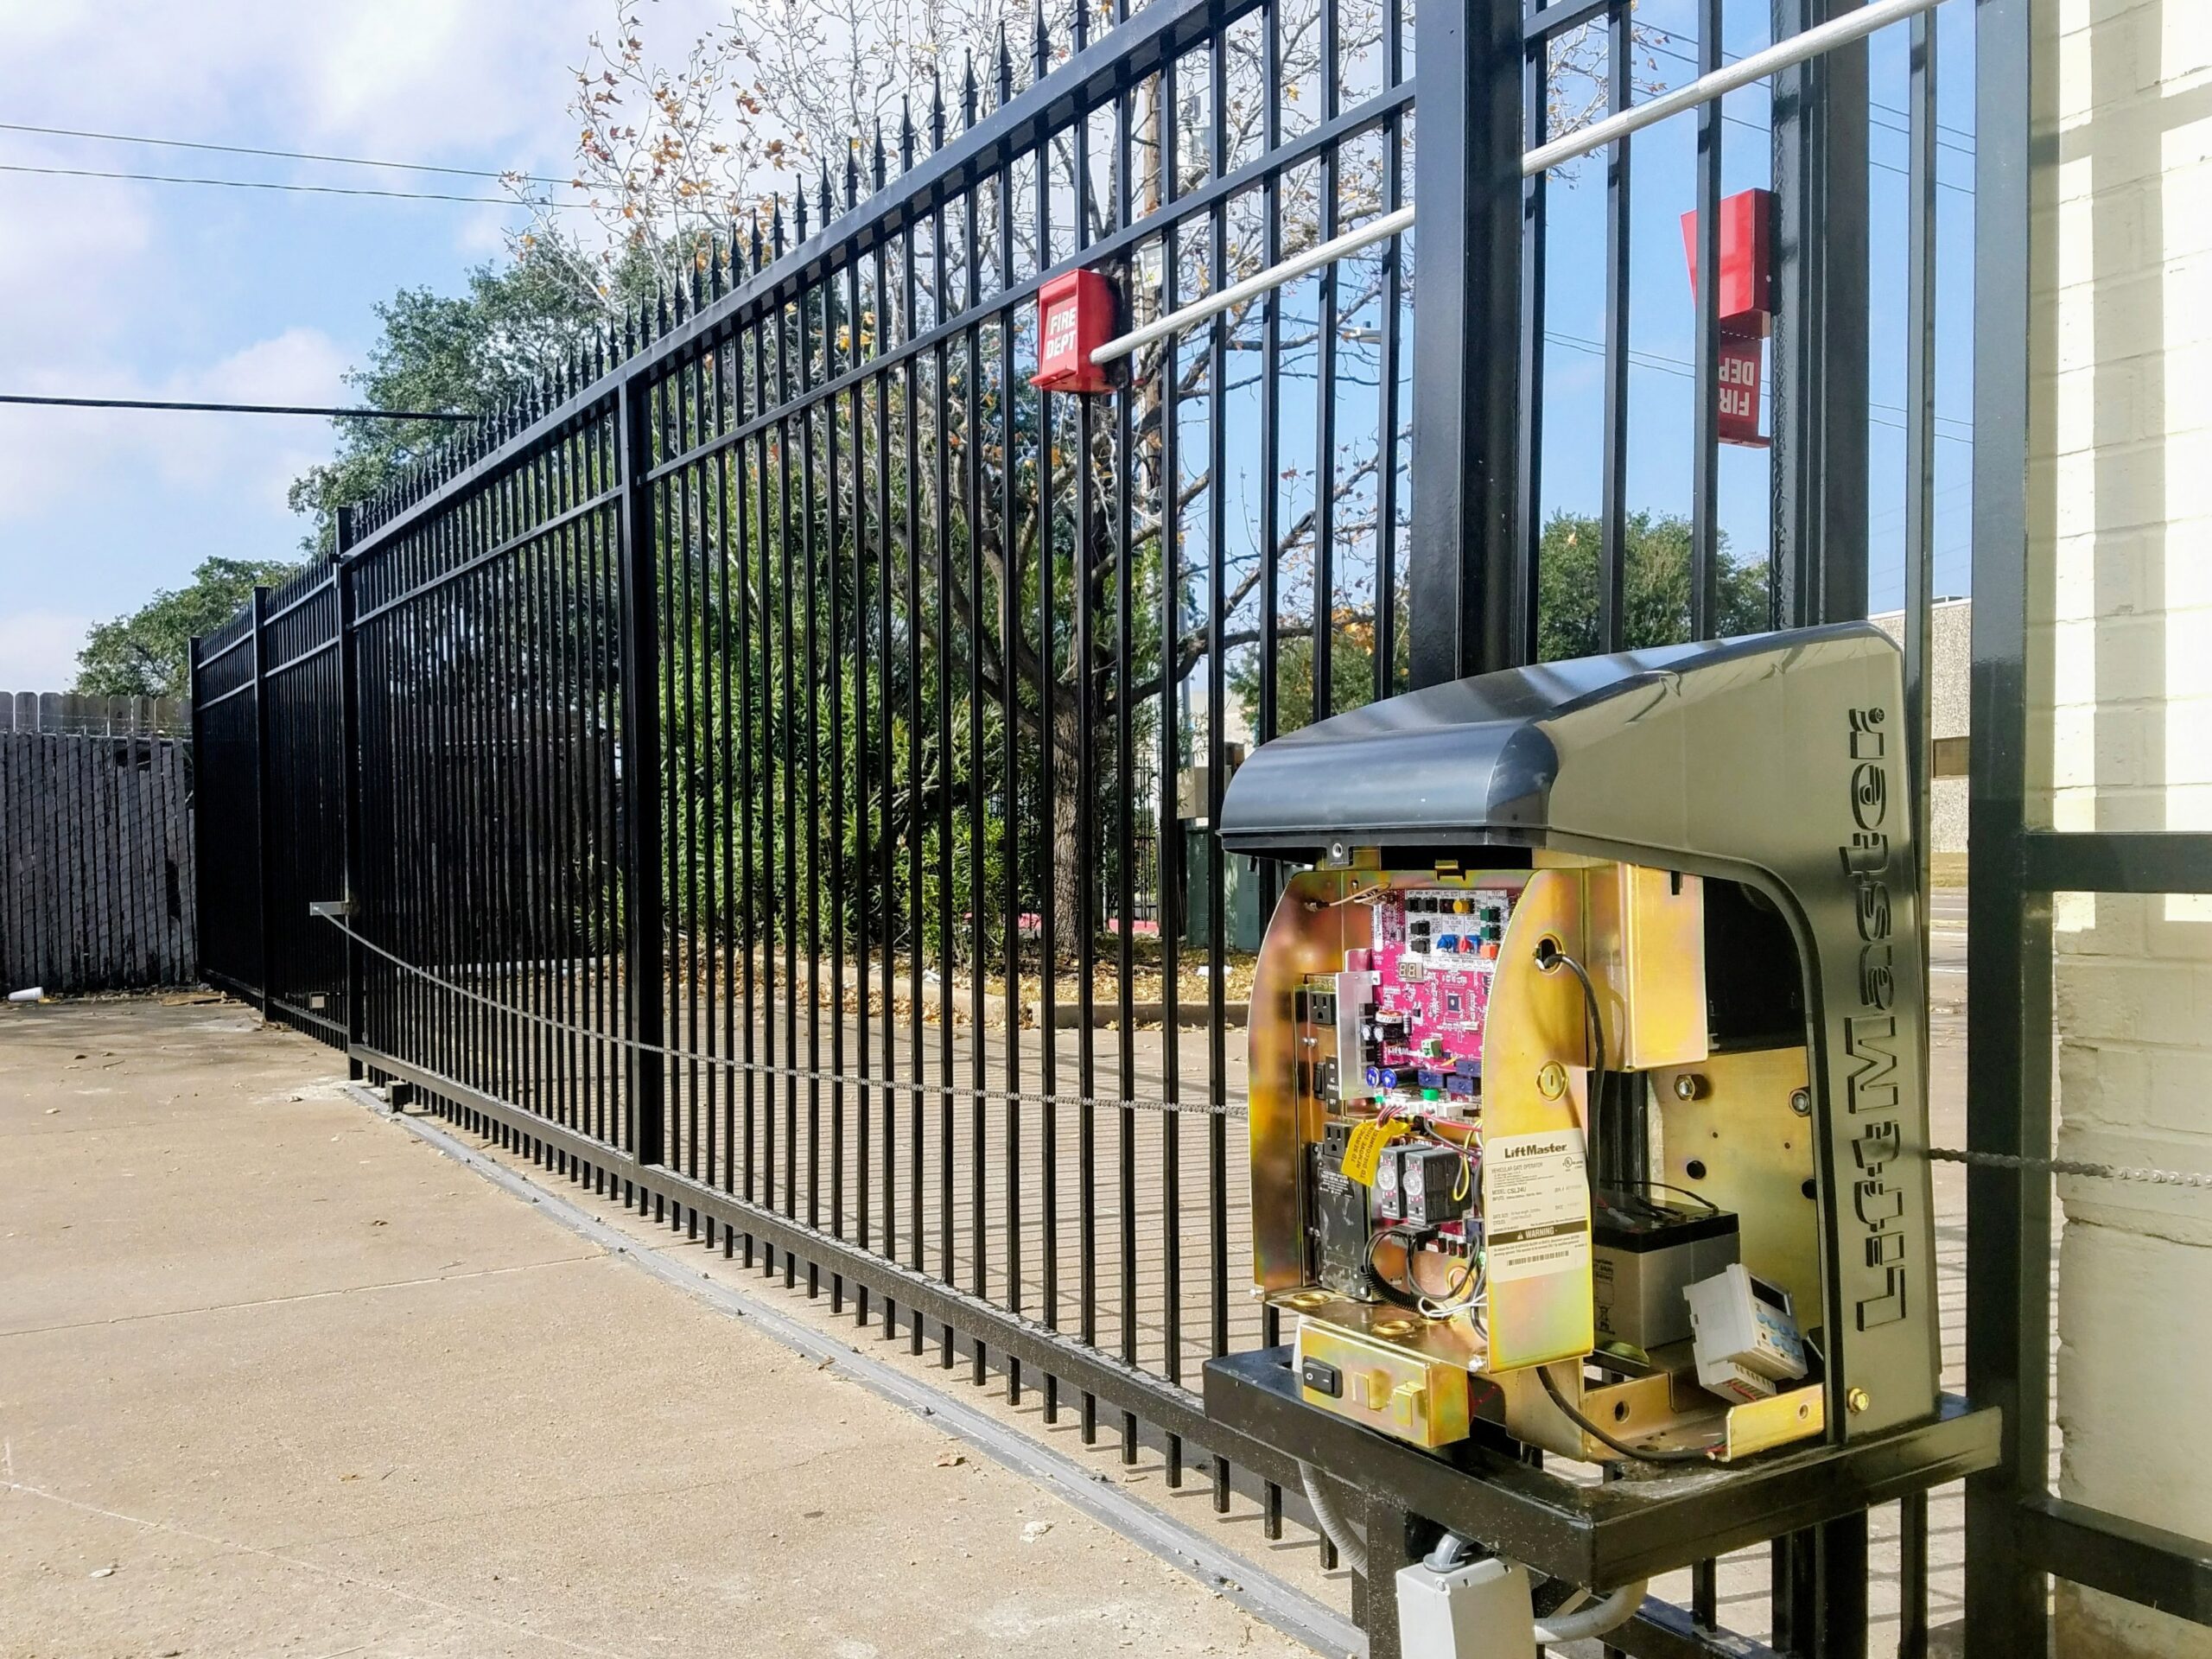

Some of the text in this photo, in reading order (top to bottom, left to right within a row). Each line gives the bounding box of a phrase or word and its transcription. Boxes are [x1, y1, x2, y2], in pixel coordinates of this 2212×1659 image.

[1049, 307, 1077, 335] FIRE
[1046, 330, 1077, 359] DEPT
[1719, 358, 1755, 386] DEP
[1719, 388, 1750, 416] FIR
[1351, 1154, 1357, 1163] TO
[1357, 1144, 1366, 1169] REMOVE
[1504, 1143, 1568, 1159] LiftMaster
[1360, 1168, 1367, 1179] TO
[1525, 1226, 1554, 1239] WARNING
